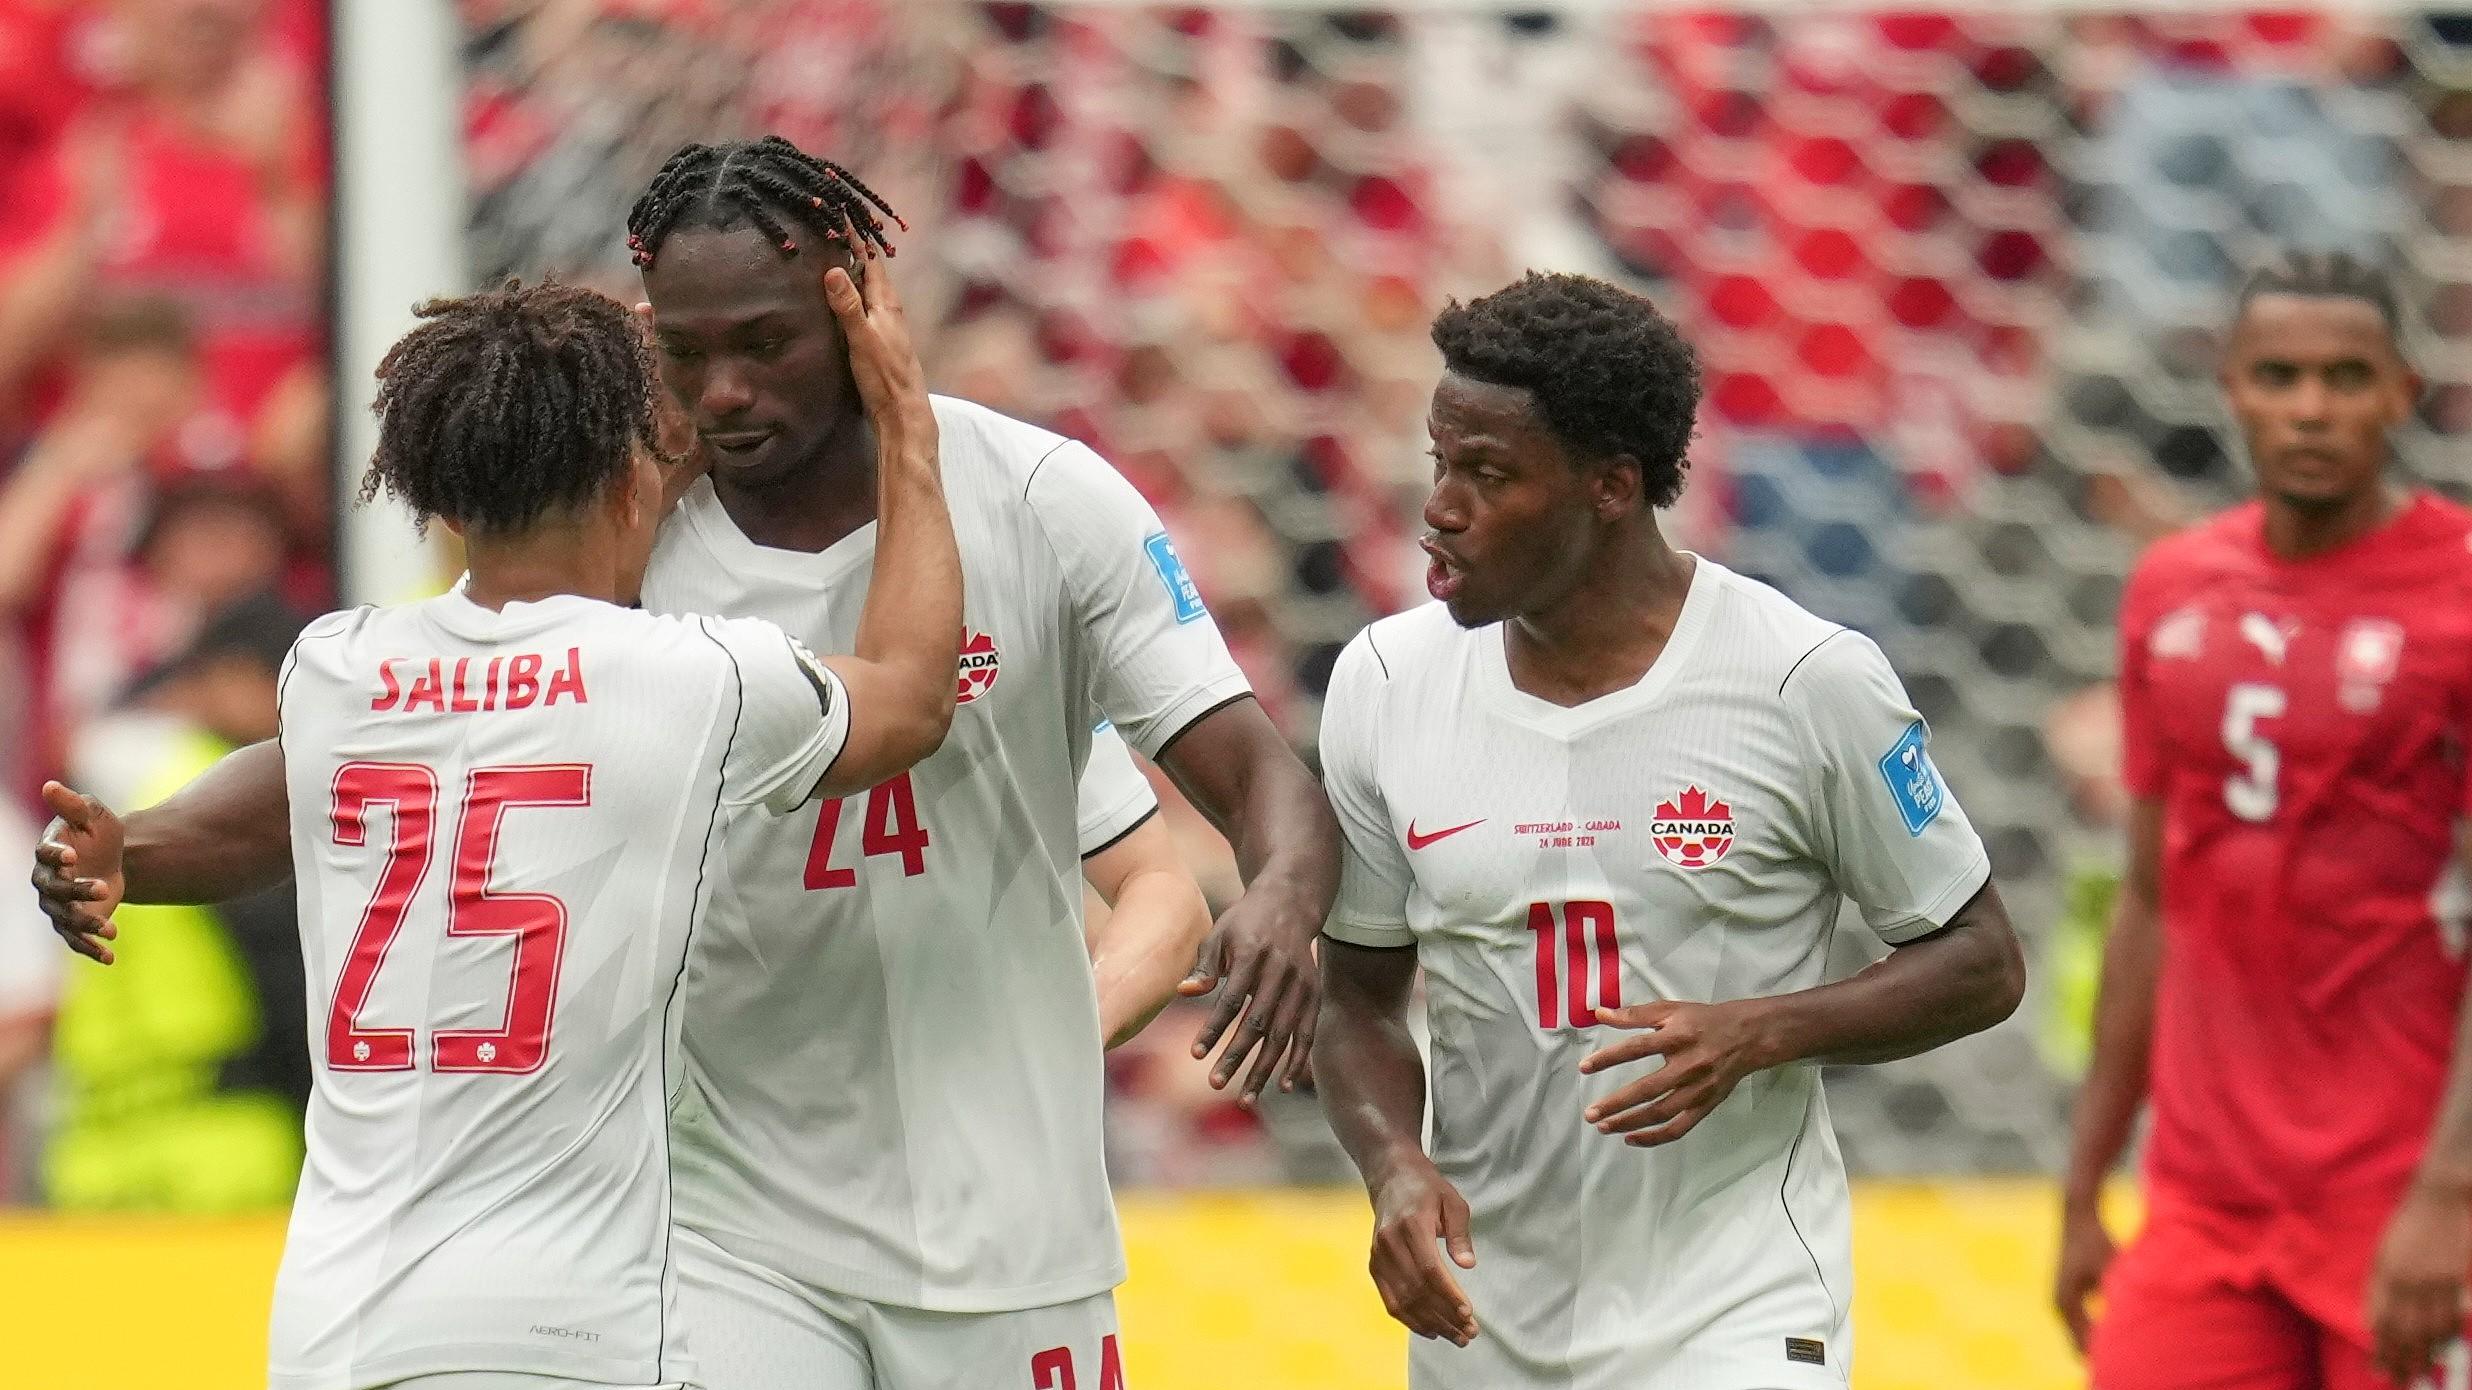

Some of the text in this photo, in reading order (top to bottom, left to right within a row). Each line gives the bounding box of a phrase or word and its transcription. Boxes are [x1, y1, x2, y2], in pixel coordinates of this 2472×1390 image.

[371, 647, 588, 713] SALIBA
[959, 653, 999, 670] ADA
[2222, 683, 2287, 823] 5
[804, 769, 930, 891] 24
[1651, 822, 1734, 835] CANADA
[327, 760, 593, 1075] 25
[1527, 900, 1621, 1029] 10
[529, 1324, 602, 1342] AERO-FIT
